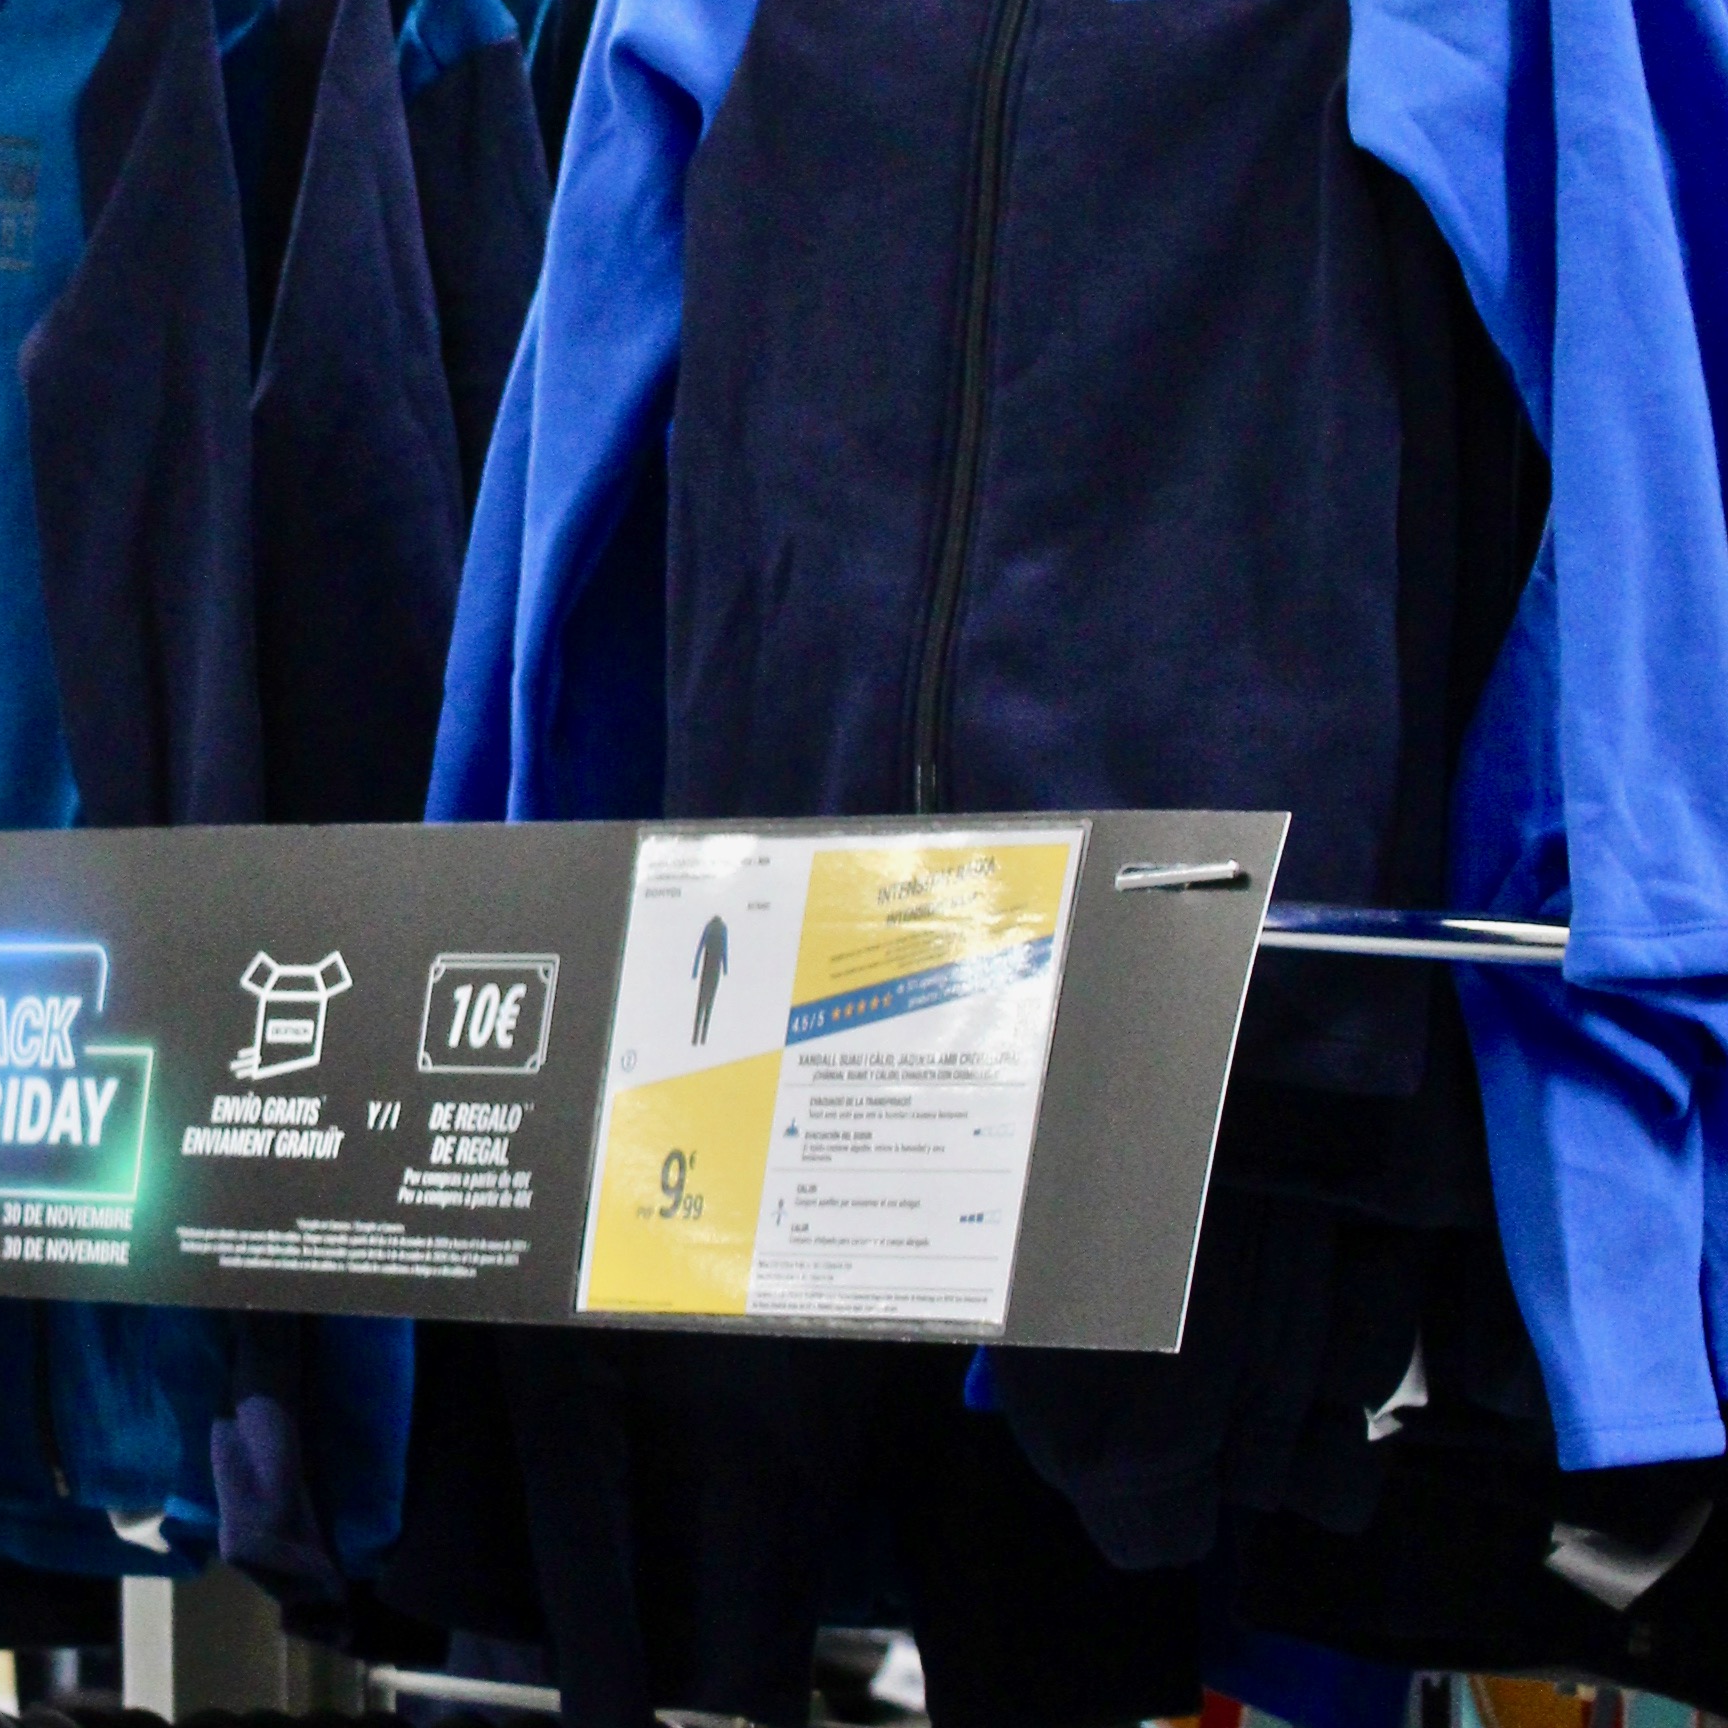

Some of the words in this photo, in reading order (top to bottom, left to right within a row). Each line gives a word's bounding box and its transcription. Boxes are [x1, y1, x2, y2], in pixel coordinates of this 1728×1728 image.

[448, 982, 528, 1050] 10€
[428, 1101, 457, 1132] DE
[181, 1125, 276, 1157] ENVIAMENT
[430, 1134, 458, 1166] DE
[455, 1135, 510, 1167] REGAL
[2, 1202, 22, 1227] 30
[24, 1202, 44, 1228] DE
[45, 1204, 135, 1232] NOVIEMBRE
[2, 1234, 22, 1261] 30
[23, 1235, 44, 1263] DE
[45, 1237, 131, 1266] NOVEMBRE
